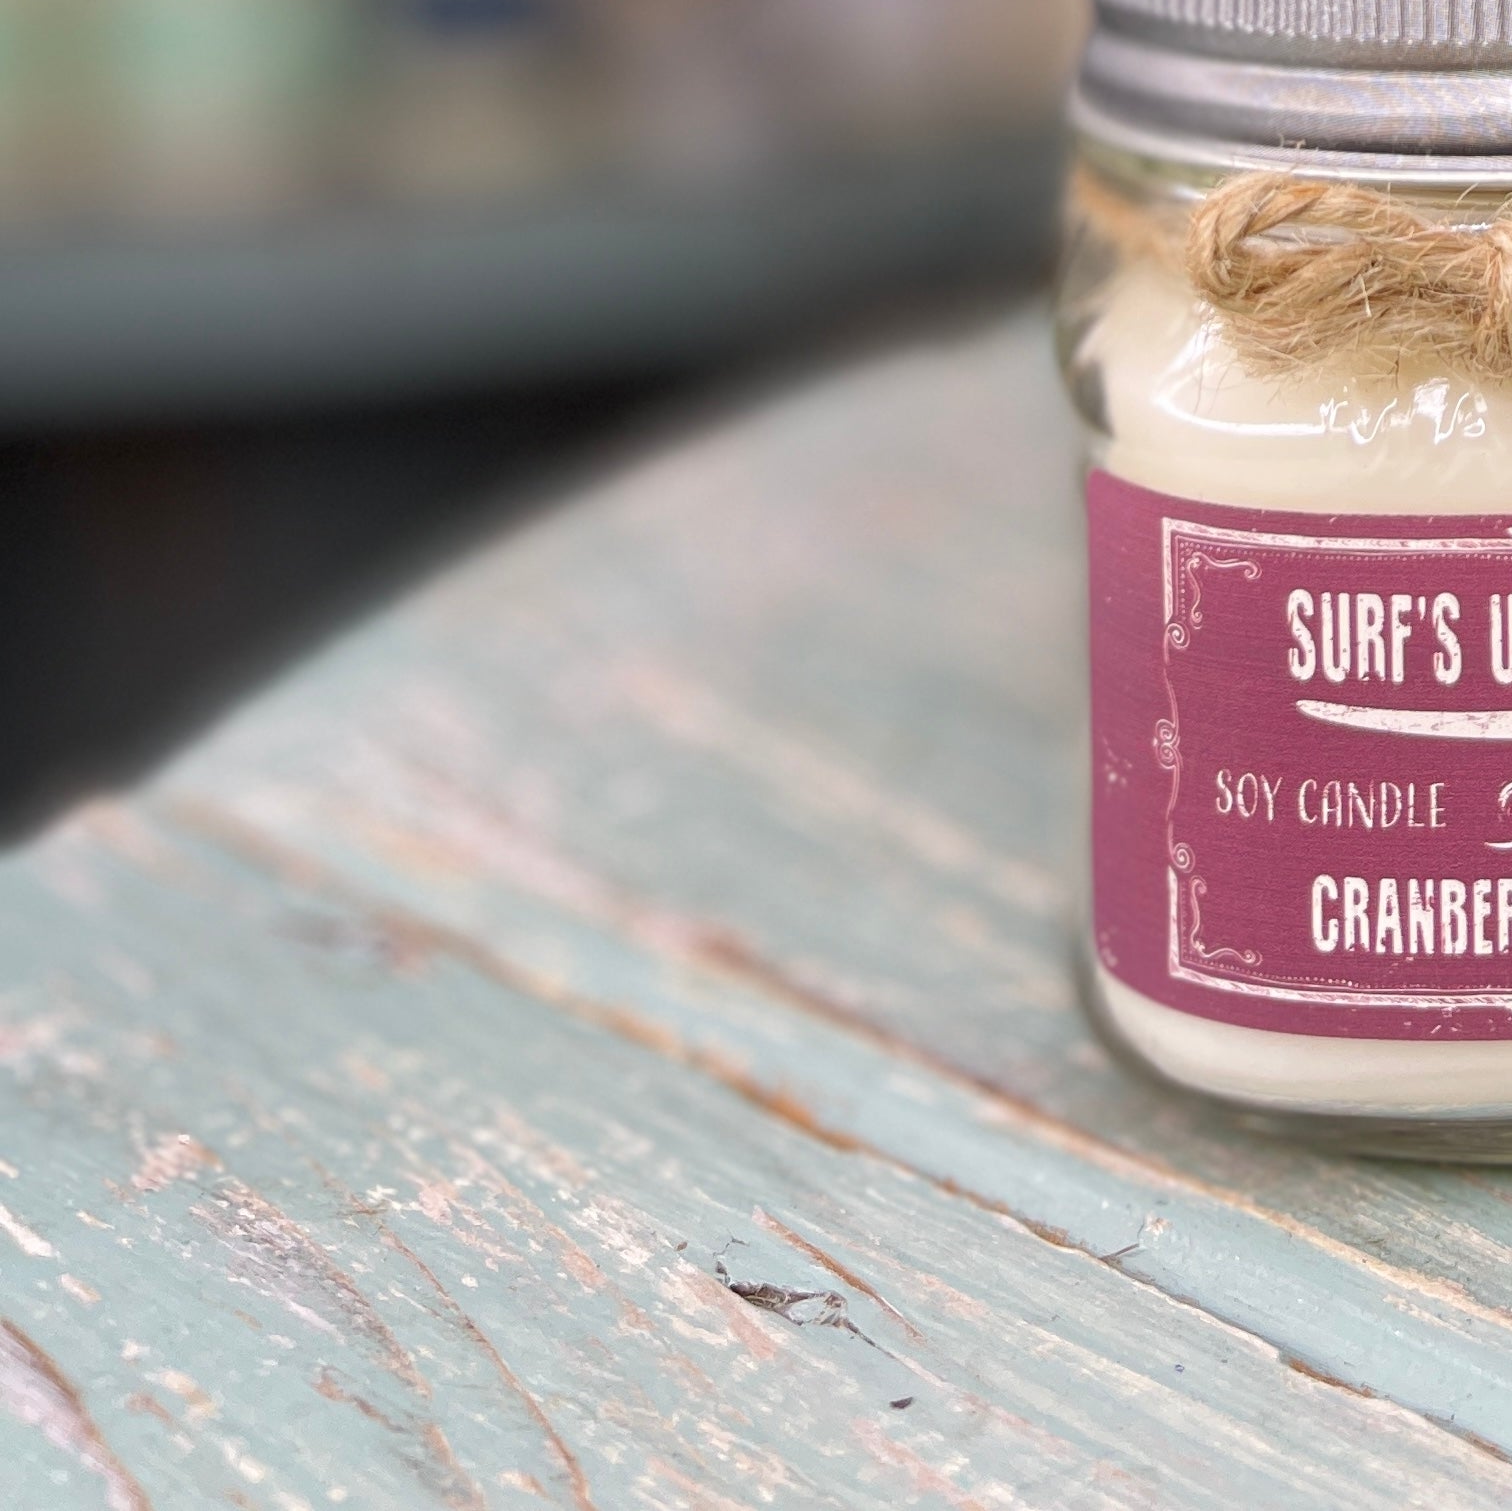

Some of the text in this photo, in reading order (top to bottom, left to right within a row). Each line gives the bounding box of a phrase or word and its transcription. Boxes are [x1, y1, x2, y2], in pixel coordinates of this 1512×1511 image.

[1286, 588, 1462, 686] SURF'S
[1215, 769, 1447, 829] SOY CANDLE
